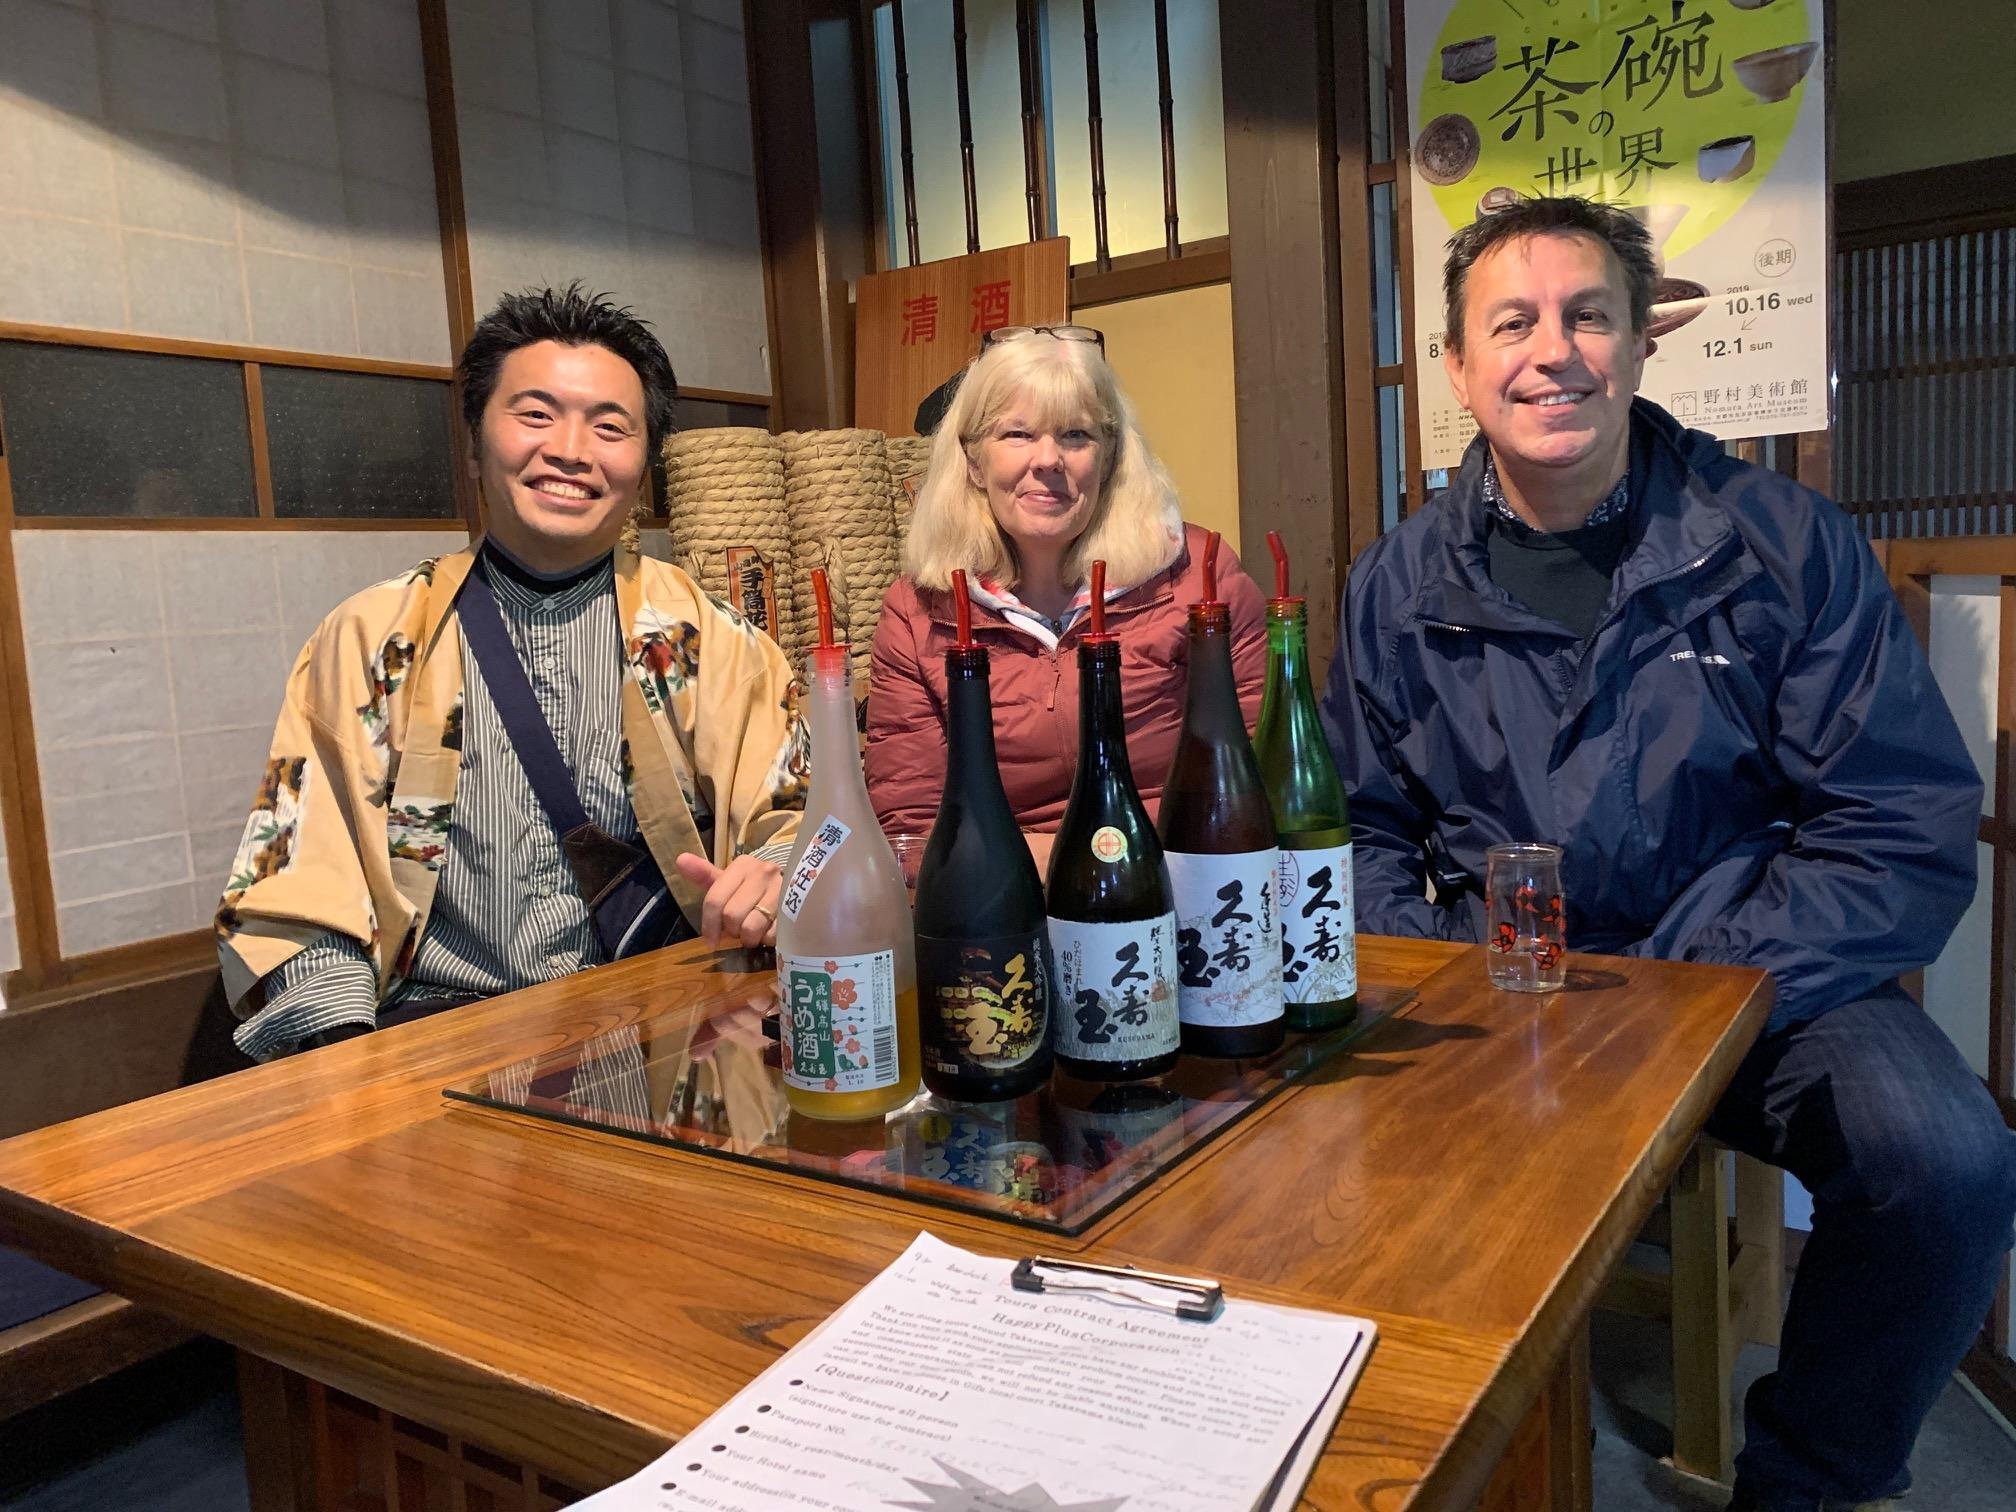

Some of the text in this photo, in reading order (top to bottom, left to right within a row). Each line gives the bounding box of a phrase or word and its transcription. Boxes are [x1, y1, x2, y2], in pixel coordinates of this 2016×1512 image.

[1589, 110, 1614, 138] の
[1534, 127, 1678, 197] 世界
[1758, 248, 1792, 268] 後期
[1726, 284, 1750, 294] 2019
[902, 280, 1011, 346] 清酒
[1725, 292, 1813, 316] 10.16 wed
[1703, 337, 1773, 358] 12.1 sun
[1703, 378, 1808, 405] 野村美術館
[1704, 404, 1743, 415] Nomura
[1767, 397, 1808, 407] Museum
[784, 823, 843, 915] 清酒仕込
[1211, 879, 1253, 972] 久寿
[1302, 866, 1341, 963] 久寿
[1111, 941, 1149, 1026] 久寿
[794, 977, 820, 1060] うめ酒
[871, 1311, 898, 1325] Thank
[995, 1294, 1037, 1310] Tours
[1043, 1305, 1112, 1327] Contract
[1118, 1320, 1209, 1344] Agreement
[992, 1312, 1180, 1355] HappyPlusCorporation
[803, 1383, 960, 1429] Name Signature all person
[850, 1411, 872, 1422] use
[873, 1416, 893, 1427] for
[770, 1409, 823, 1433] Passport
[749, 1430, 802, 1450] Birthday
[726, 1449, 754, 1463] Your
[756, 1457, 792, 1474] Hotel
[701, 1468, 731, 1484] Your
